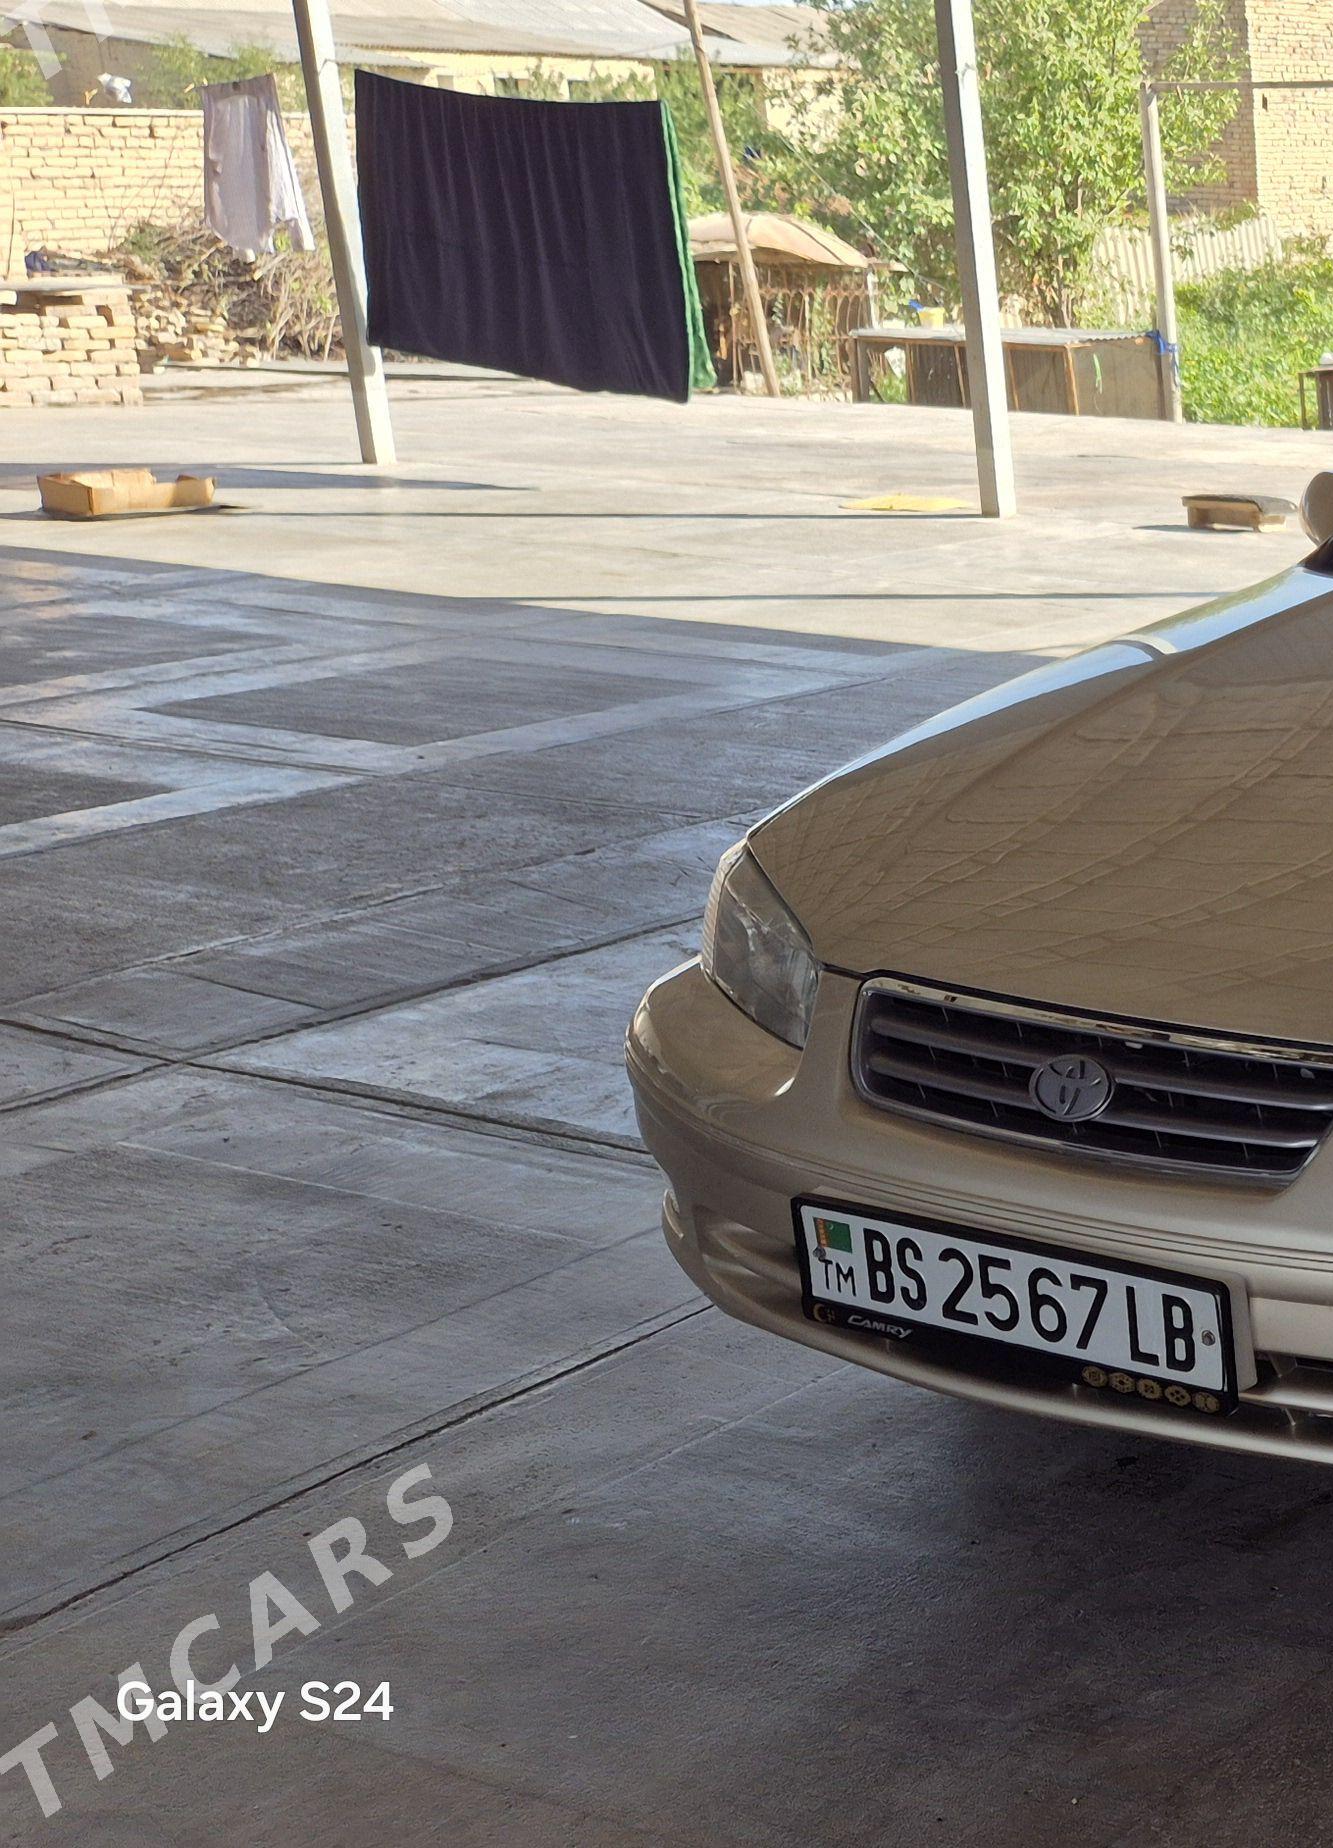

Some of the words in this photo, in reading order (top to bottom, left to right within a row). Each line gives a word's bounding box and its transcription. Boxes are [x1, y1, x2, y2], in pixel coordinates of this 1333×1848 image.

[820, 1258, 857, 1297] TM
[863, 1228, 927, 1311] BS
[938, 1247, 1108, 1350] 2567
[1125, 1285, 1196, 1373] LB
[847, 1314, 912, 1338] CAMRY
